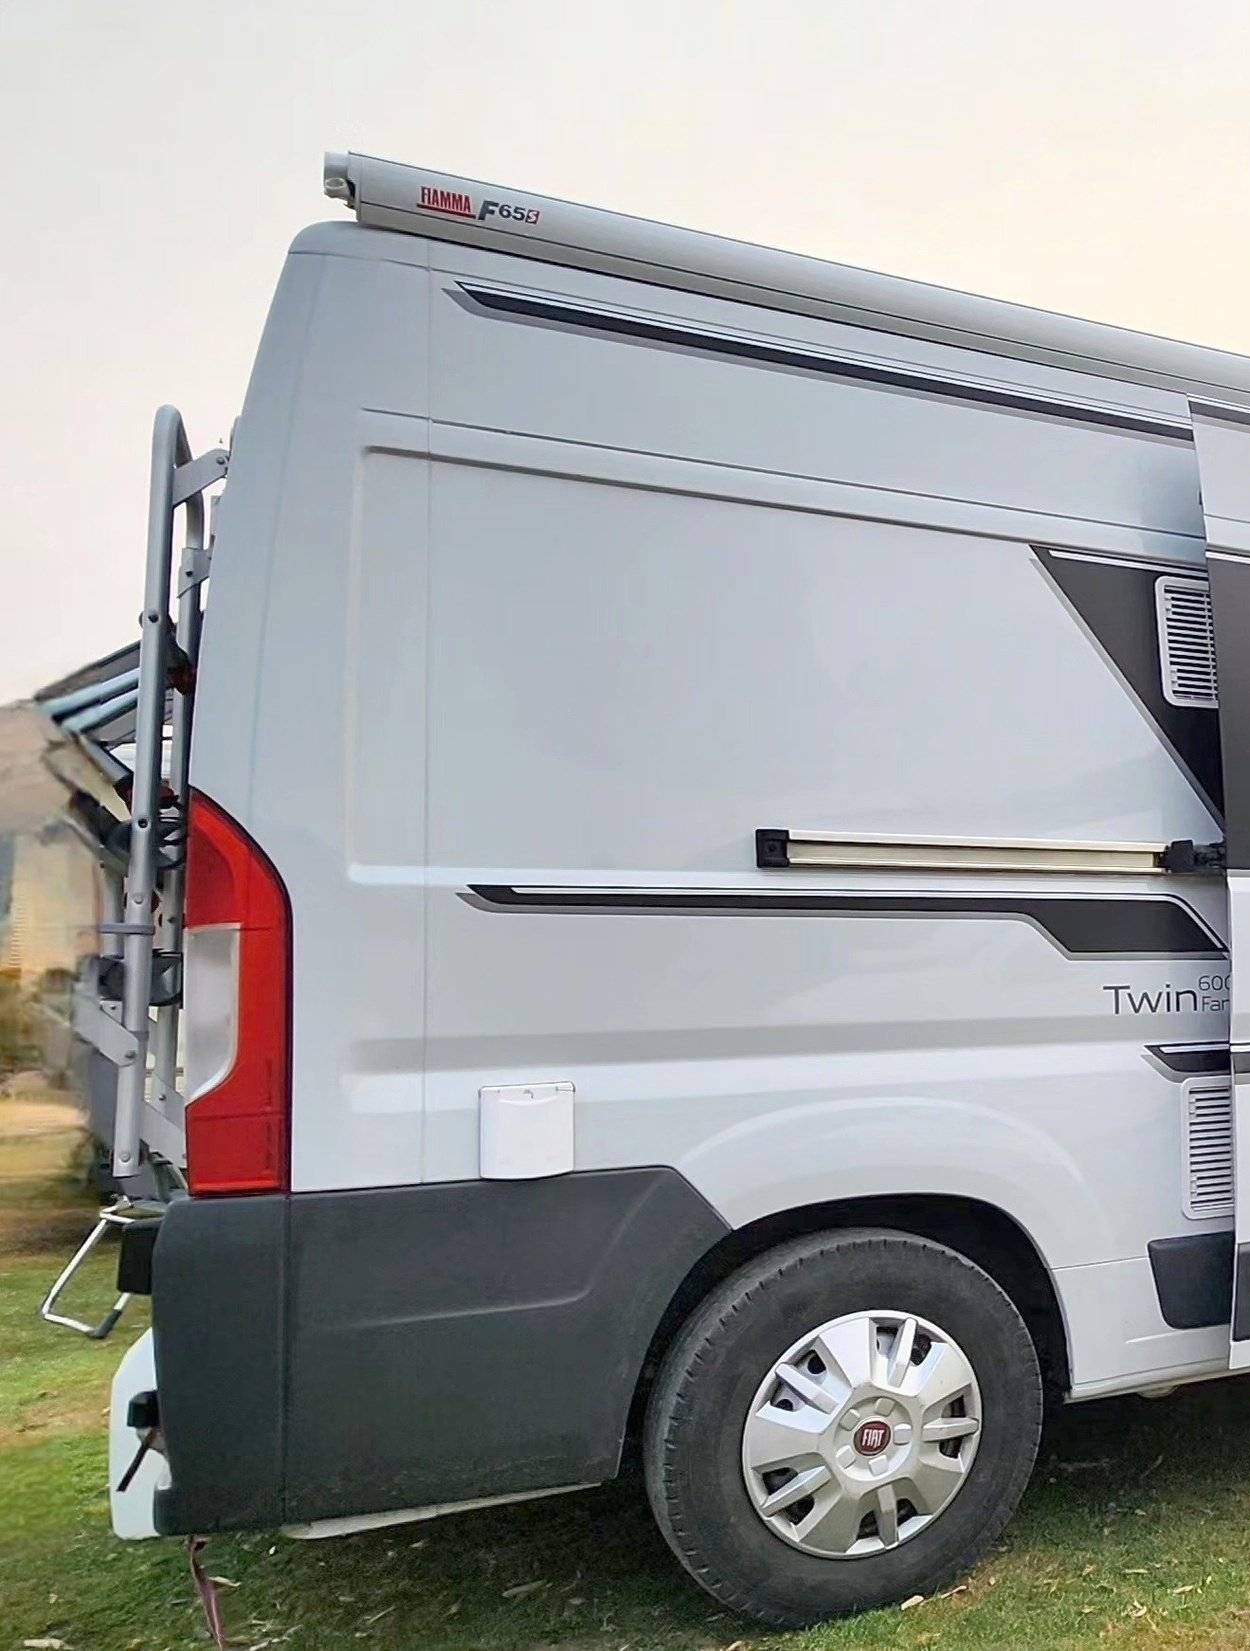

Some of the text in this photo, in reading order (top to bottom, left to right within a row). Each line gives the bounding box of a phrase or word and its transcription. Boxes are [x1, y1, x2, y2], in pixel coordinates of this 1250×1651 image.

[420, 186, 472, 213] FIAMMA
[1102, 983, 1198, 1015] Twin
[862, 1429, 885, 1448] FIAT
